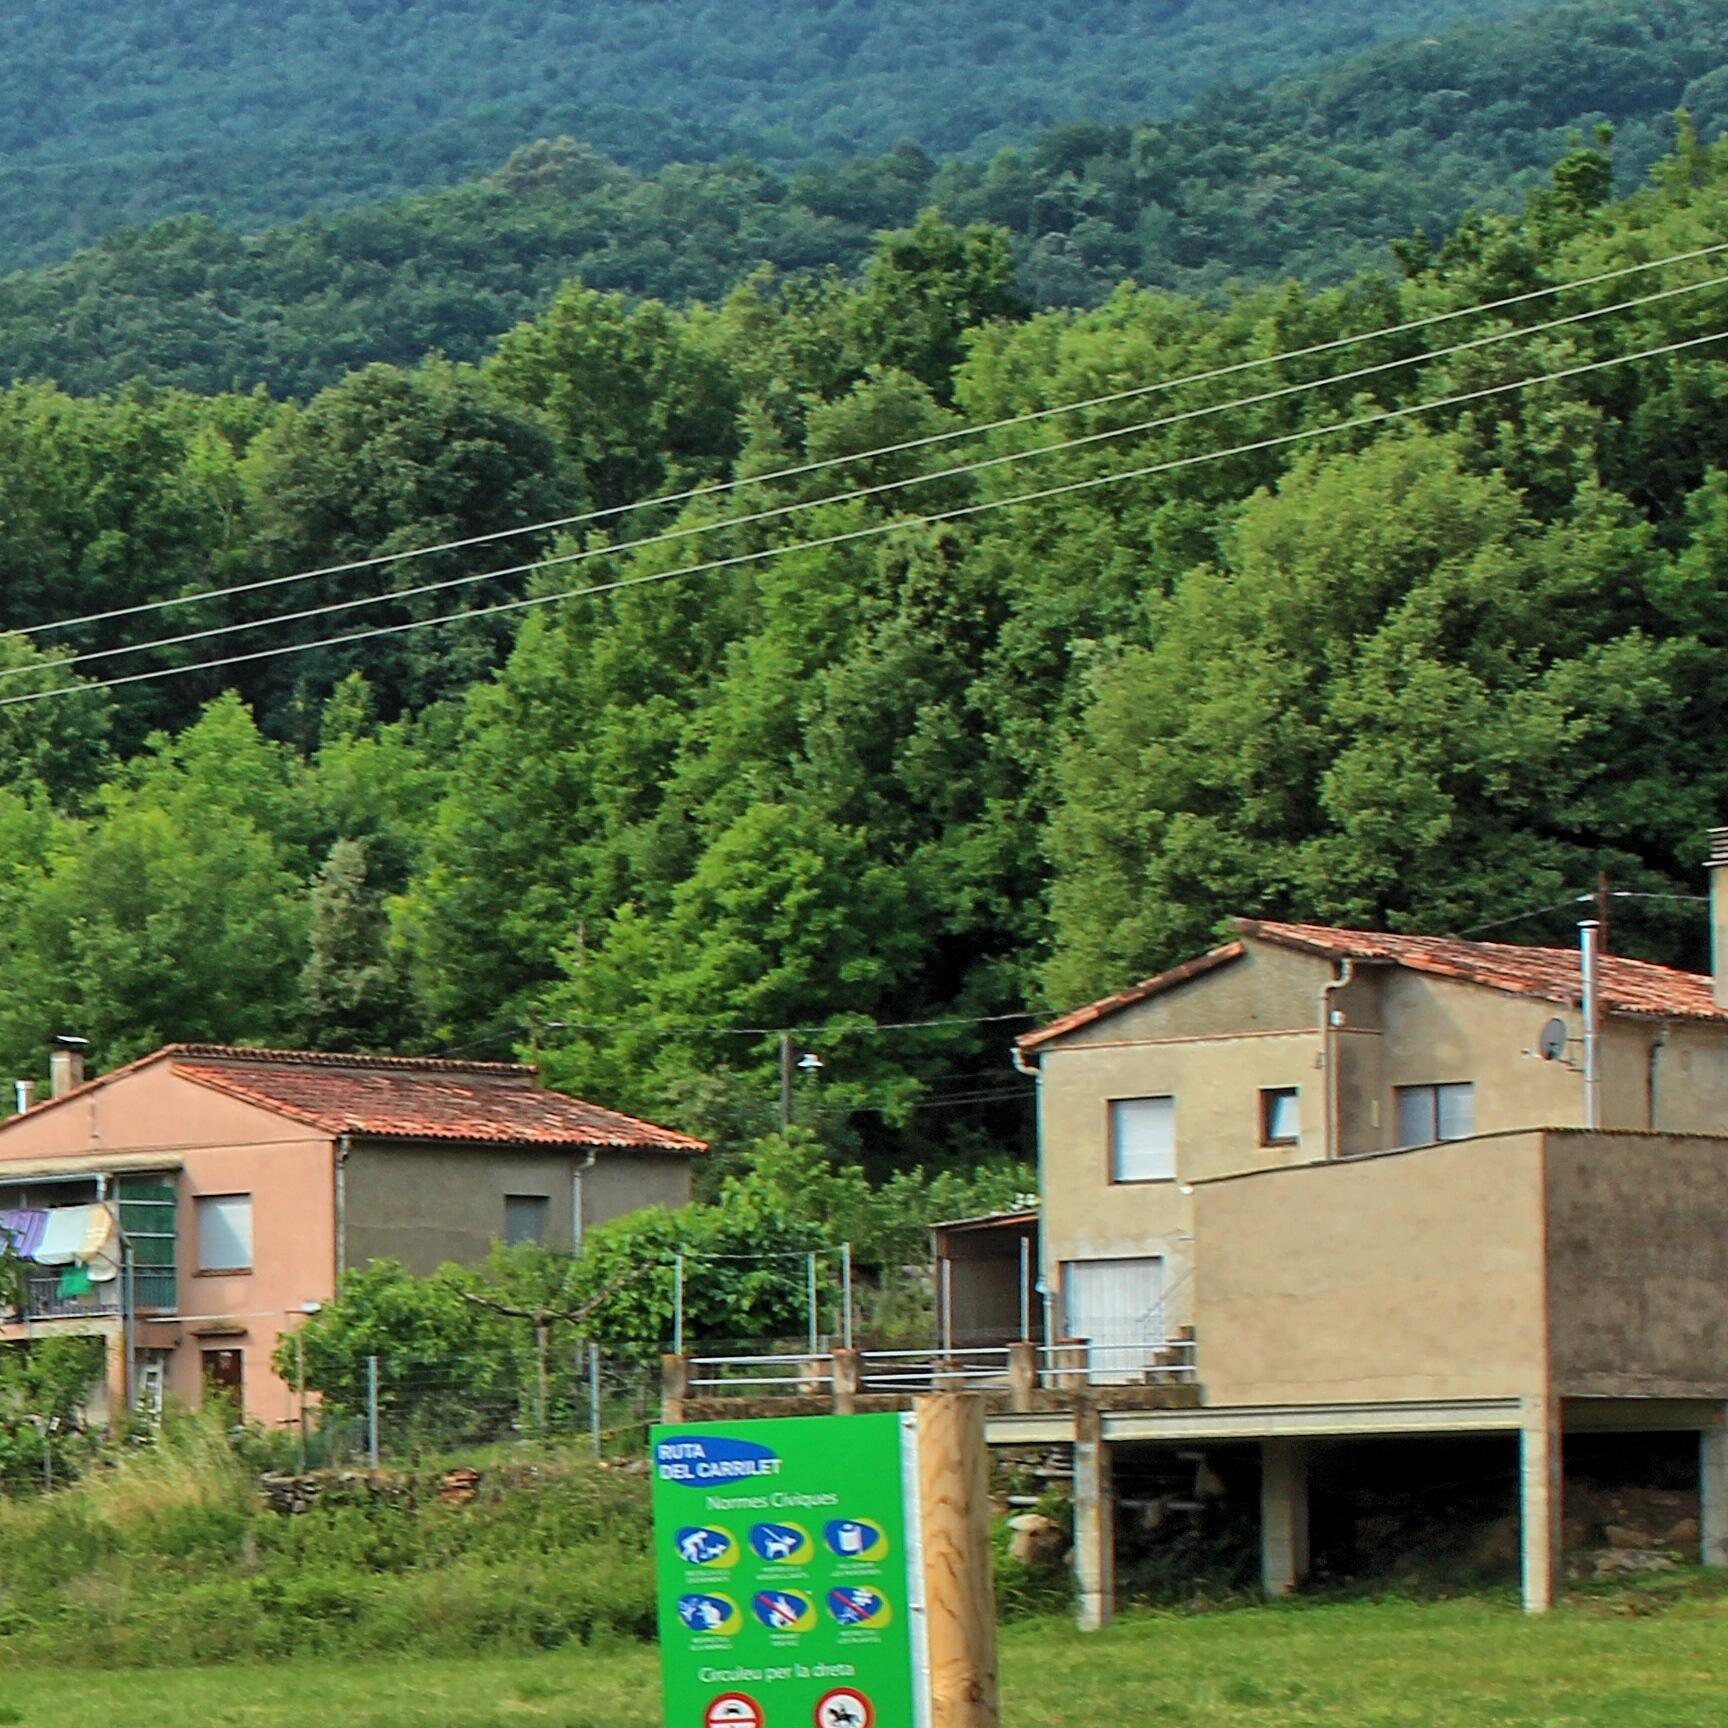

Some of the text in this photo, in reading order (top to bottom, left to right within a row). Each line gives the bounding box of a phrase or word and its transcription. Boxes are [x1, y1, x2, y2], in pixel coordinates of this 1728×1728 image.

[658, 1443, 706, 1459] RUTA
[659, 1459, 783, 1479] DEL CARRILET
[705, 1496, 768, 1510] Normes
[698, 1662, 855, 1682] Circuleu per la dreta
